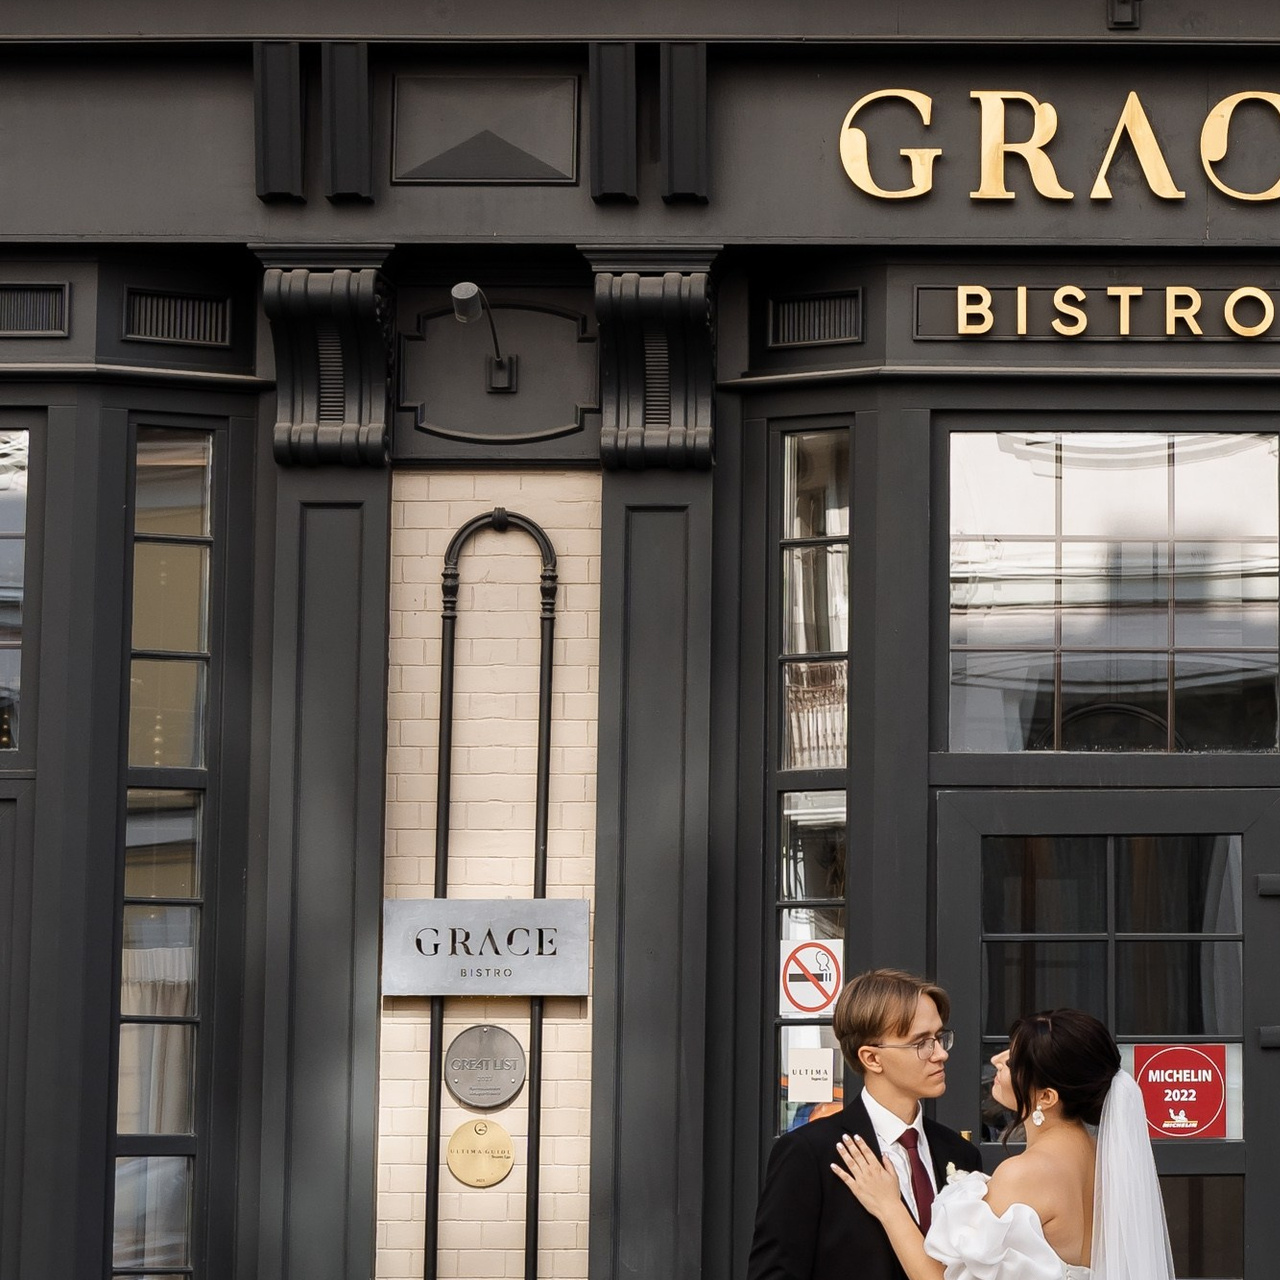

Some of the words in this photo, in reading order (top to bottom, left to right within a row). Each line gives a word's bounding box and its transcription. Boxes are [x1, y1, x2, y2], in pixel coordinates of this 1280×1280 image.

[957, 285, 1275, 337] BISTRO
[415, 927, 558, 957] GRACE
[460, 968, 513, 978] BISTRO
[493, 1057, 520, 1071] LIST
[1148, 1069, 1213, 1083] MICHELIN
[1163, 1089, 1197, 1102] 2022
